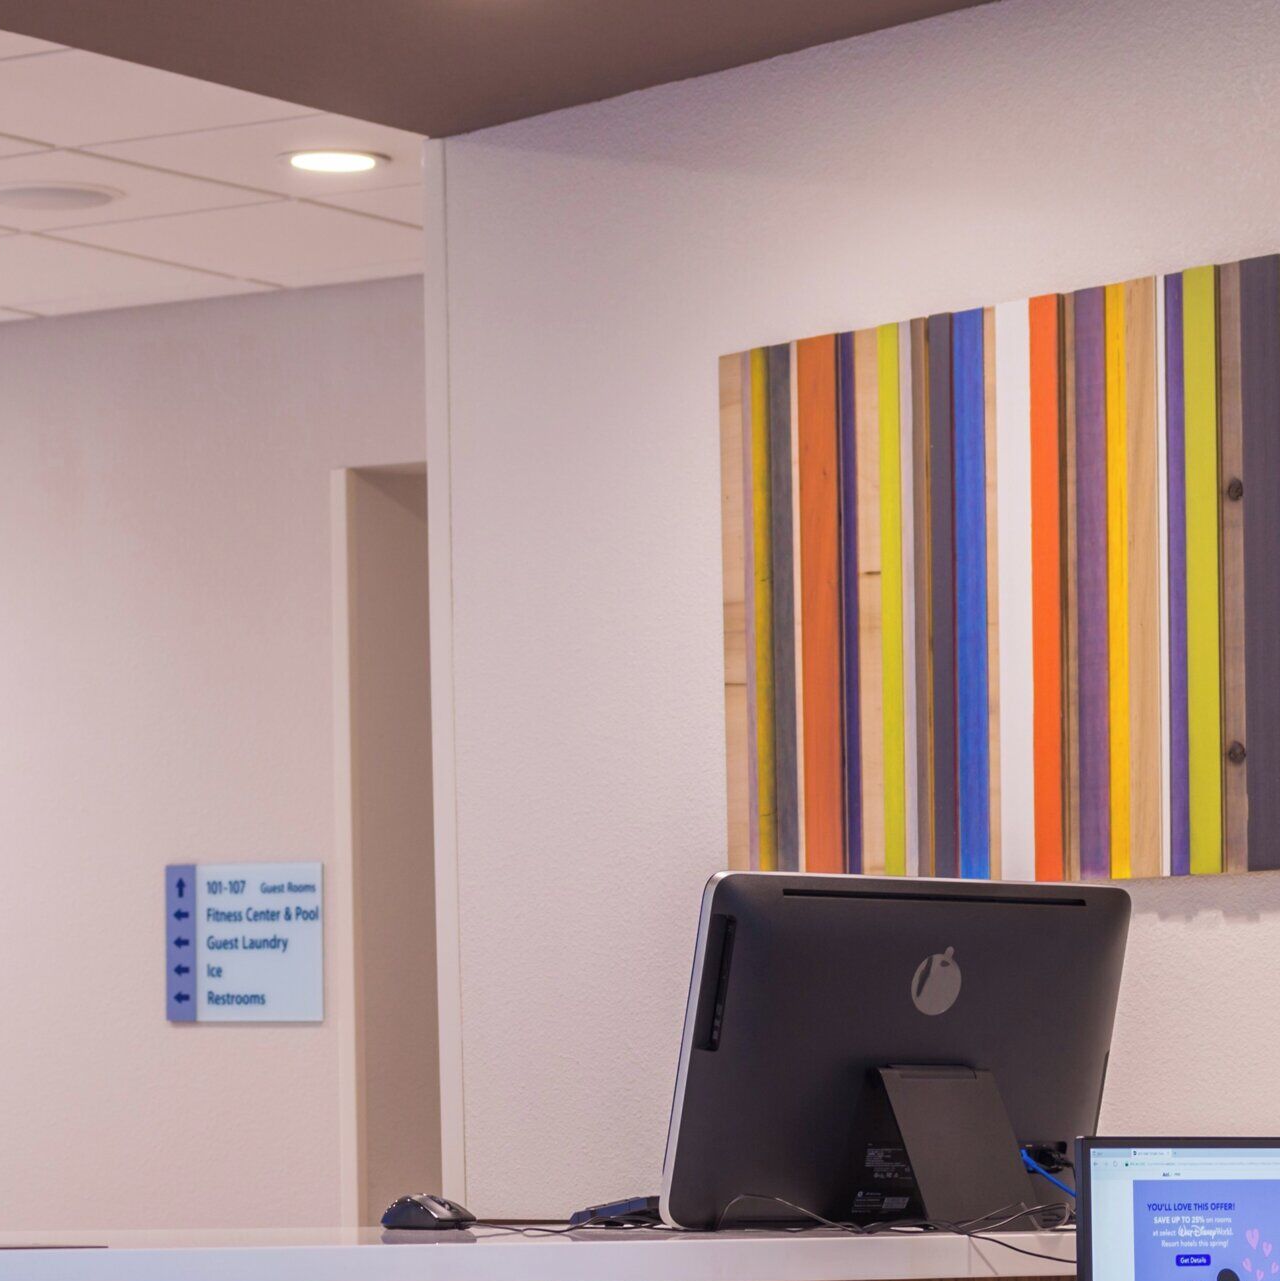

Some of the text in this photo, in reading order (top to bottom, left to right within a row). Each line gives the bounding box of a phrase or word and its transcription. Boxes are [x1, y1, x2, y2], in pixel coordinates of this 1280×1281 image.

[260, 881, 316, 894] Guest Rooms
[206, 906, 319, 922] Fitness Center & Pool
[206, 935, 288, 952] Guest Laundry
[206, 963, 223, 978] Ice
[207, 991, 266, 1005] Restrooms
[1147, 1202, 1236, 1212] YOU'LL LOVE THIS OFFER!
[1153, 1216, 1171, 1224] SAVE
[1171, 1216, 1181, 1224] UP
[1181, 1216, 1191, 1224] TO
